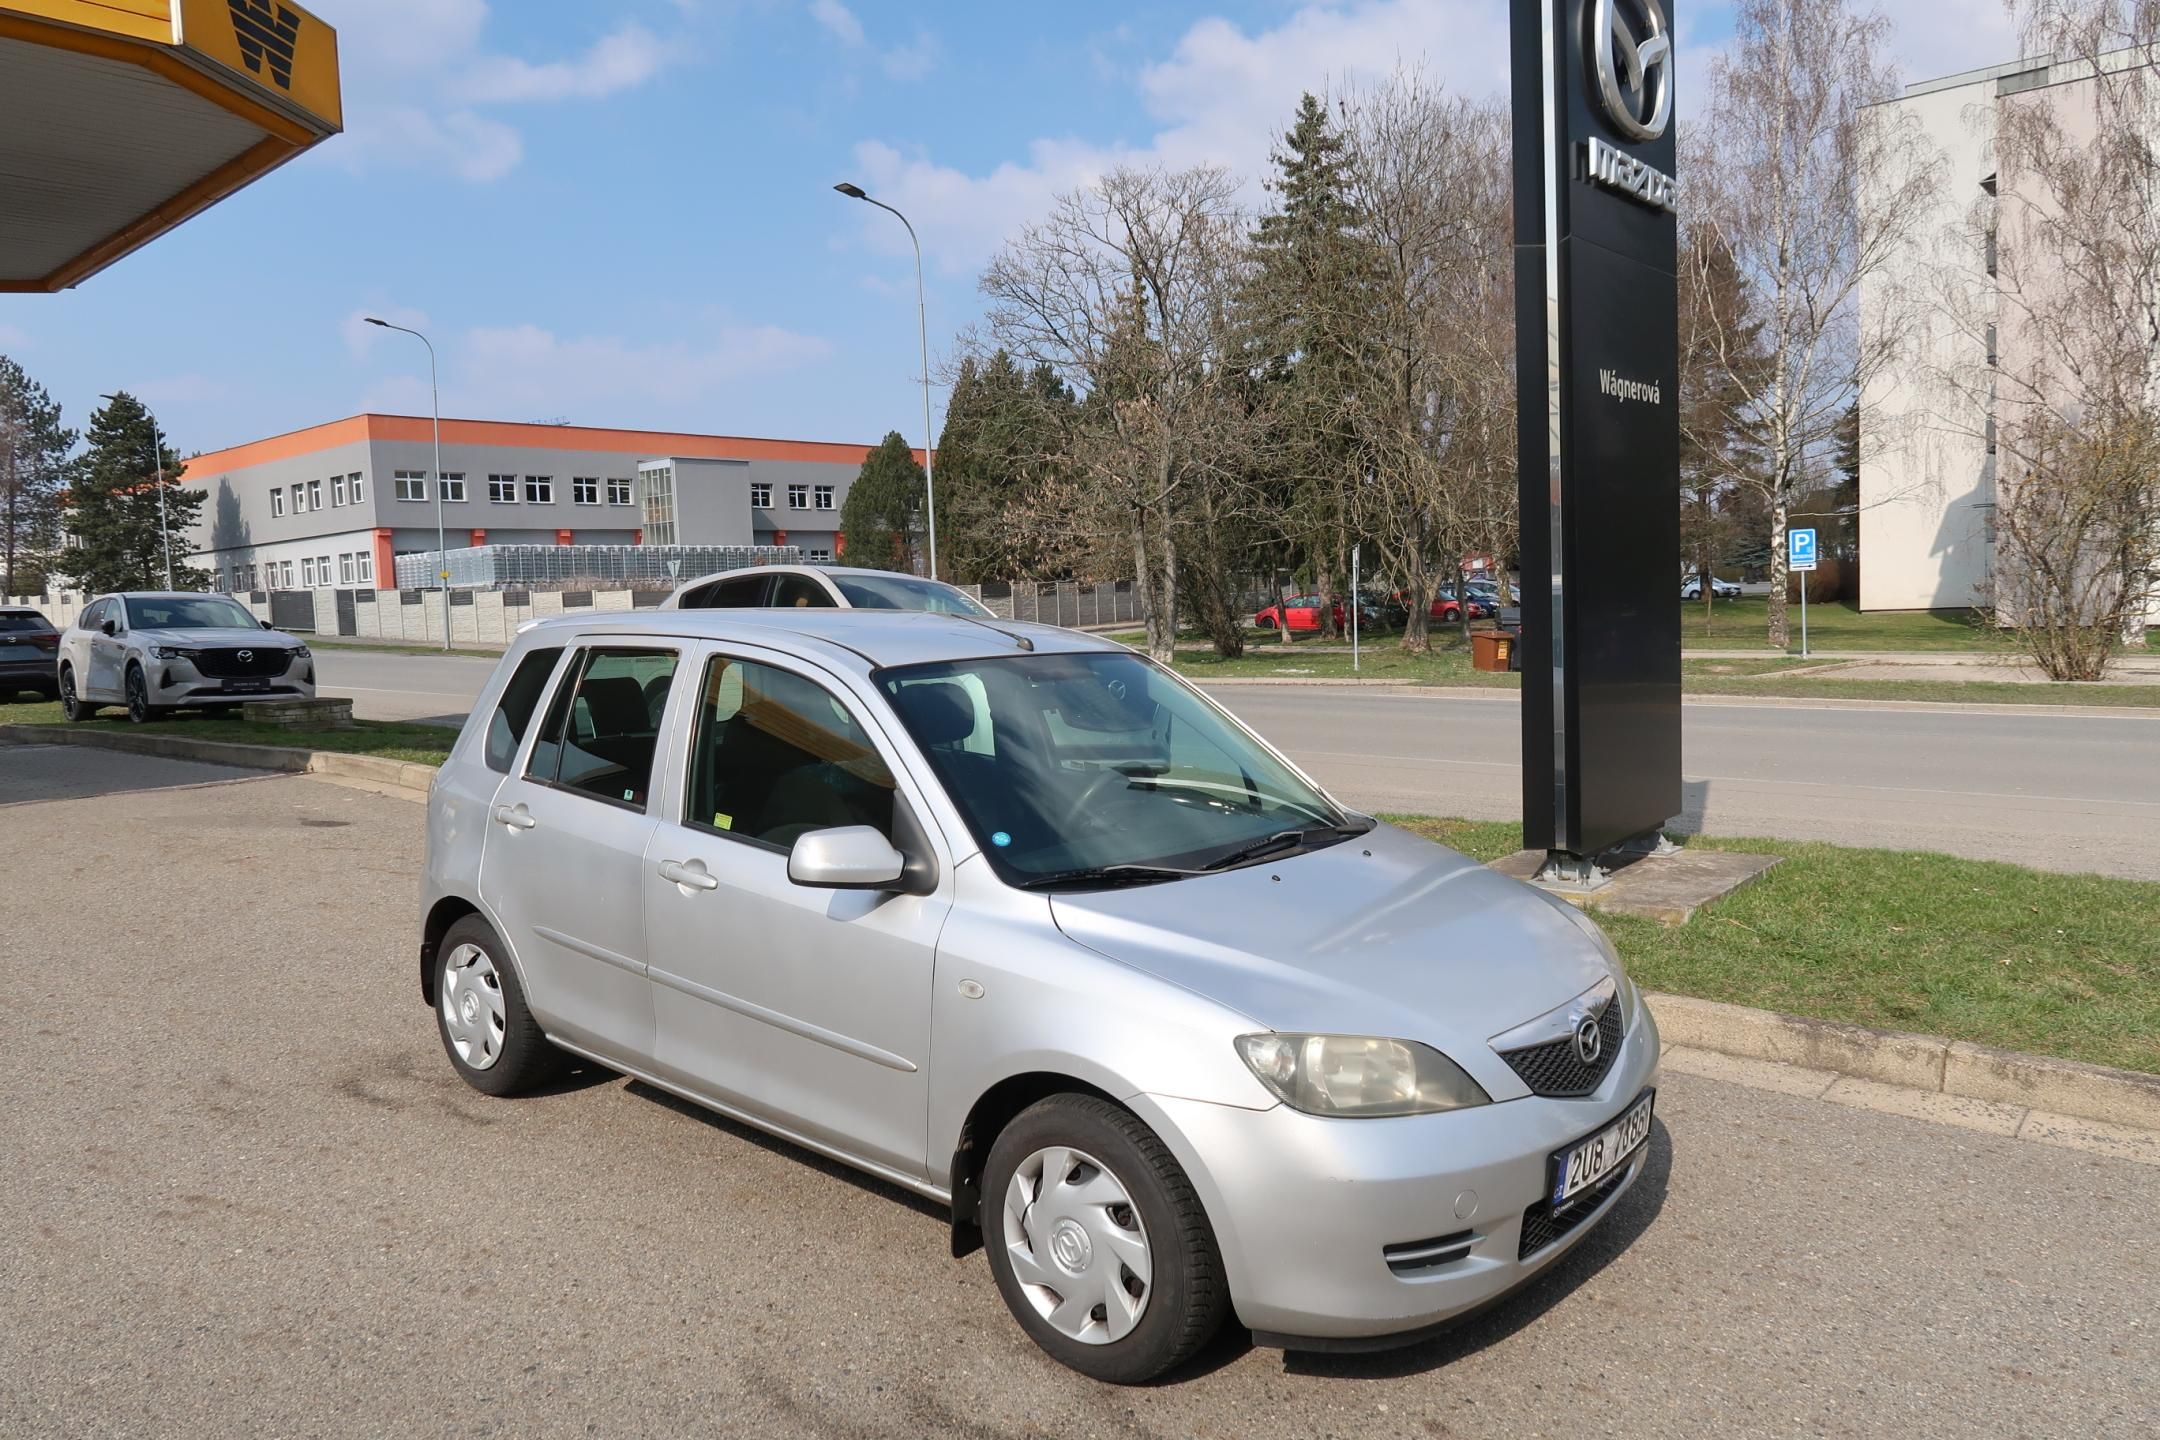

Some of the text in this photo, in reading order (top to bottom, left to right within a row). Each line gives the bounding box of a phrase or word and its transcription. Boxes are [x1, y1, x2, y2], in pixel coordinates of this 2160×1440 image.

[1600, 368, 1660, 404] Wágnerová
[1795, 533, 1810, 553] P
[1568, 1137, 1604, 1189] 2U8
